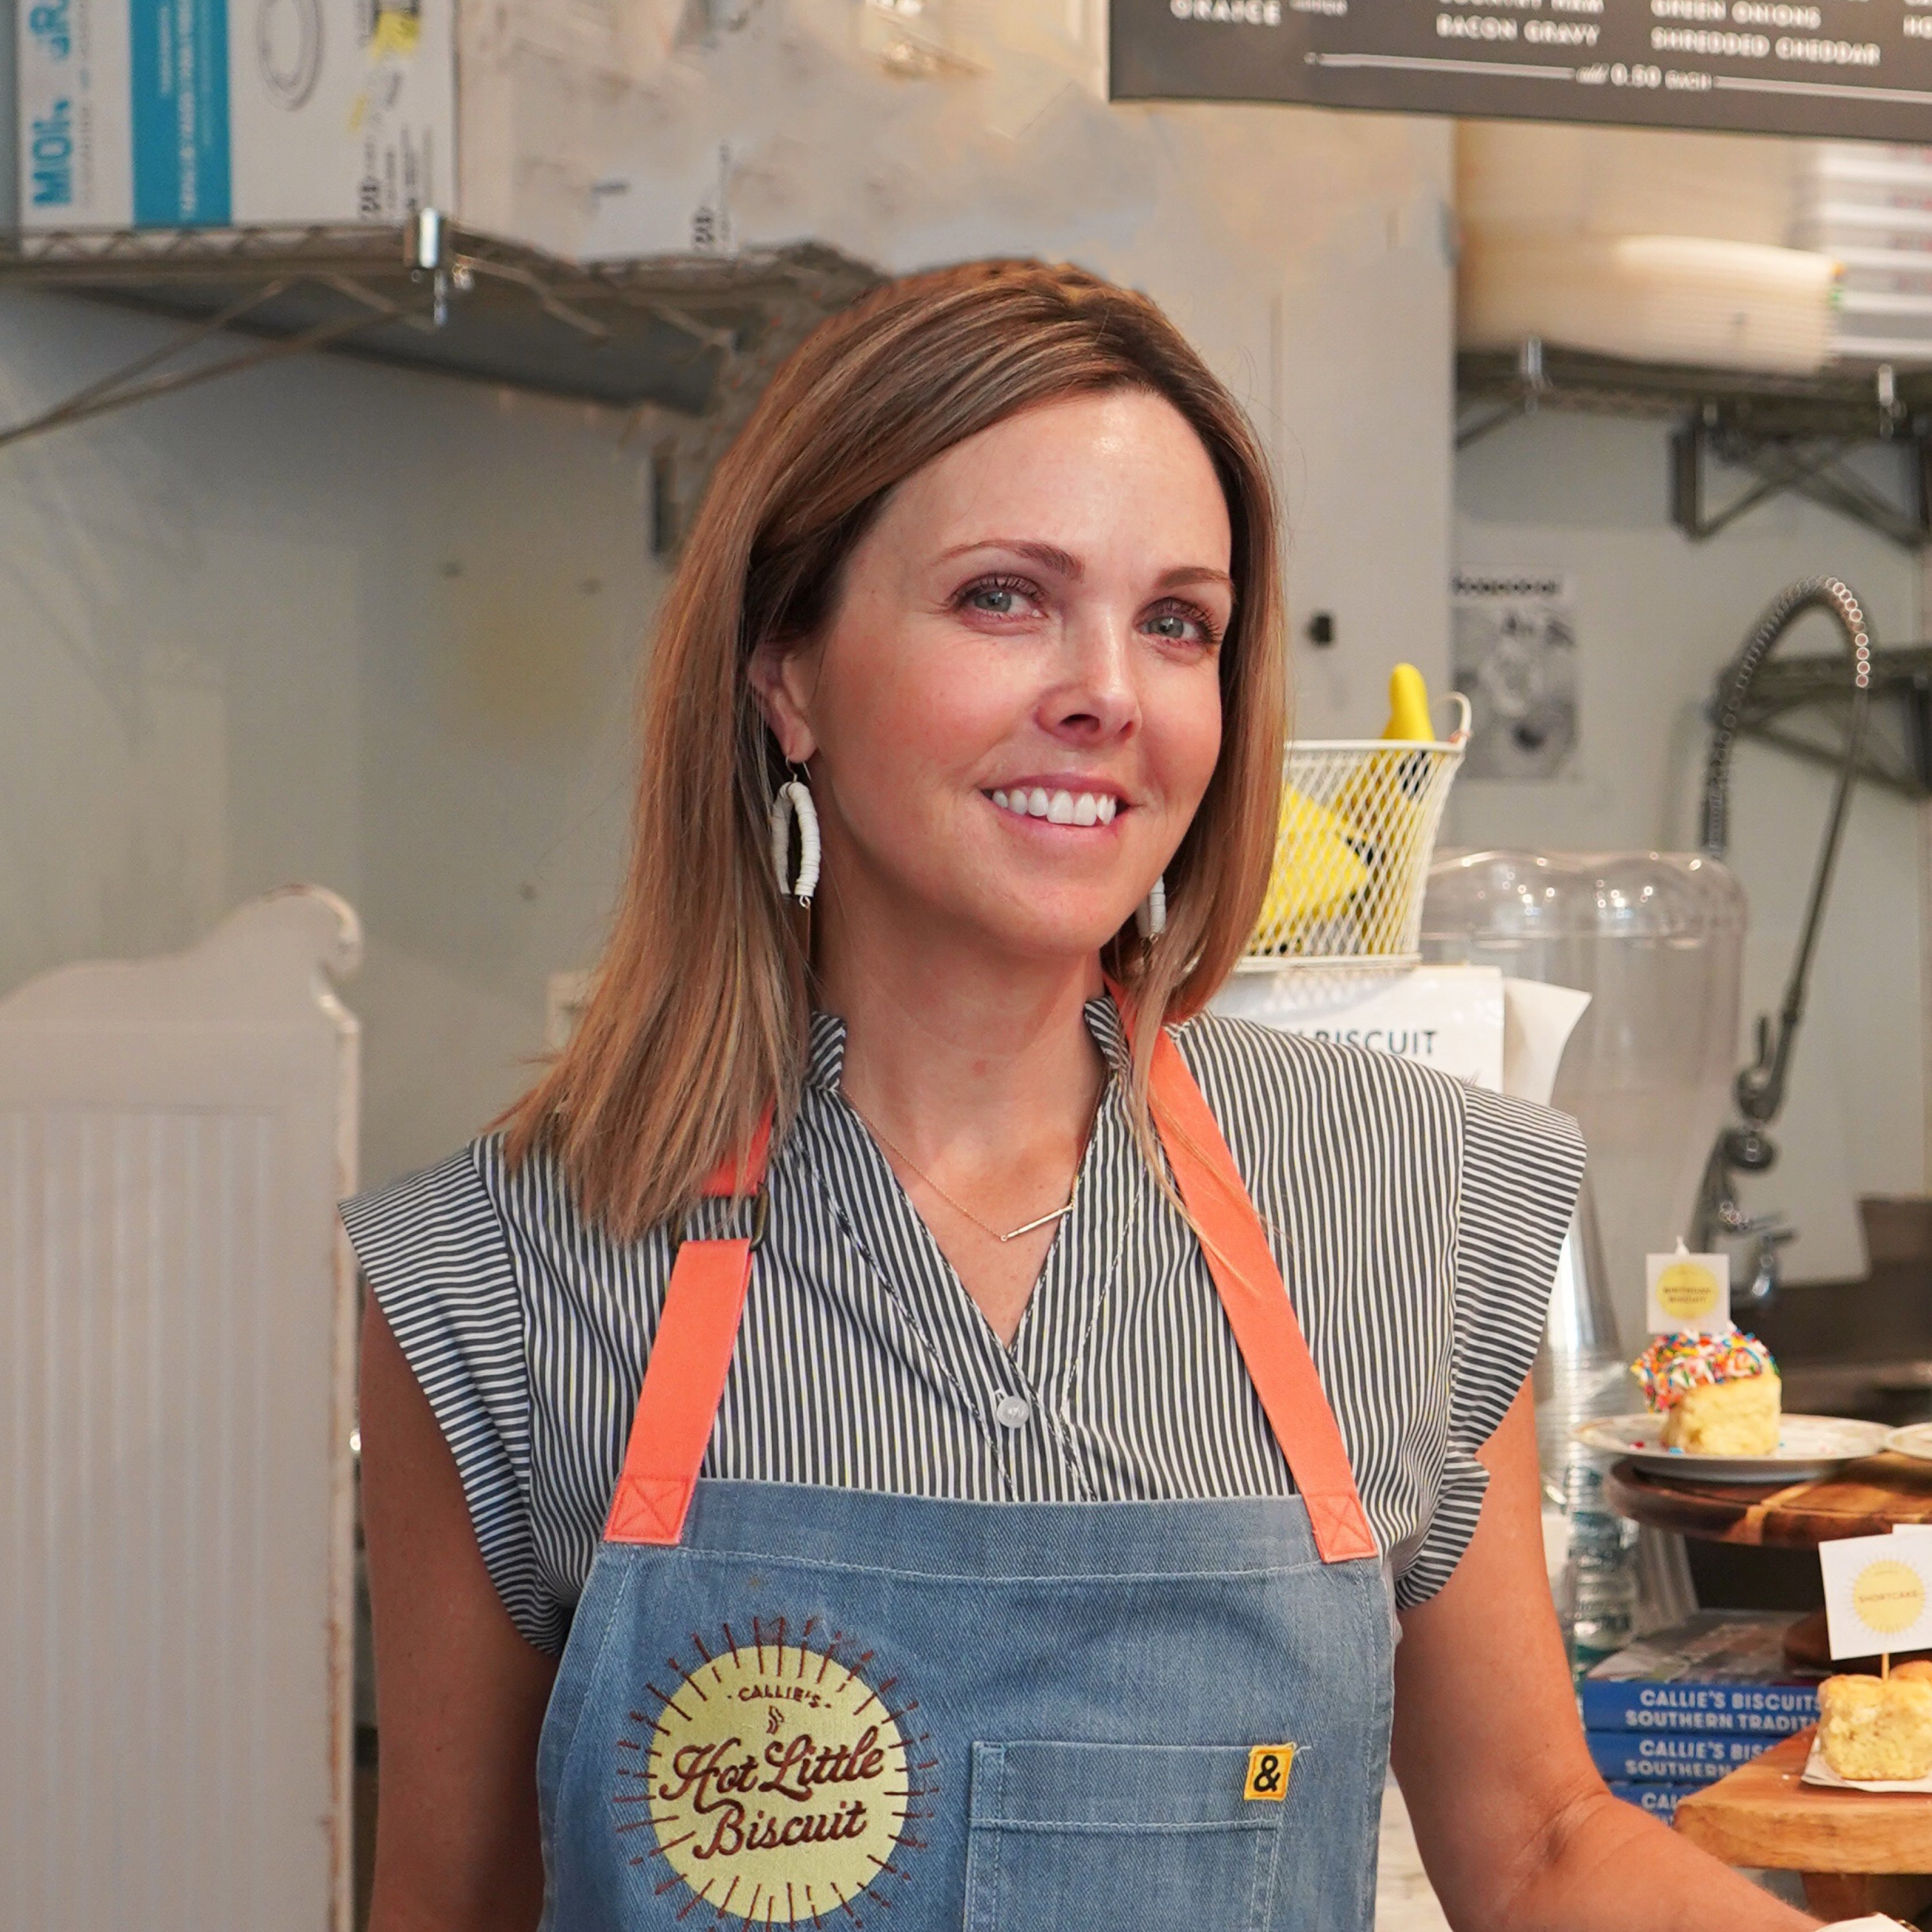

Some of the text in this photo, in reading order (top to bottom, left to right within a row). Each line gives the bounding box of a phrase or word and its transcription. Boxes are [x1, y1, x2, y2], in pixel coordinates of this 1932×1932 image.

[1651, 0, 1821, 29] GREEN ONIONS
[1436, 13, 1600, 47] BACON GRAVY
[1651, 26, 1880, 66] SHREDDED CHEDDAR
[738, 1684, 822, 1708] CALLIE'S
[1640, 1689, 1726, 1709] CALLIE'S
[1625, 1709, 1732, 1729] SOUTHERN
[1639, 1739, 1725, 1759] CALLIE'S
[659, 1726, 884, 1814] Hot Little
[1625, 1759, 1731, 1777] SOUTHERN
[693, 1799, 867, 1860] Biscuit
